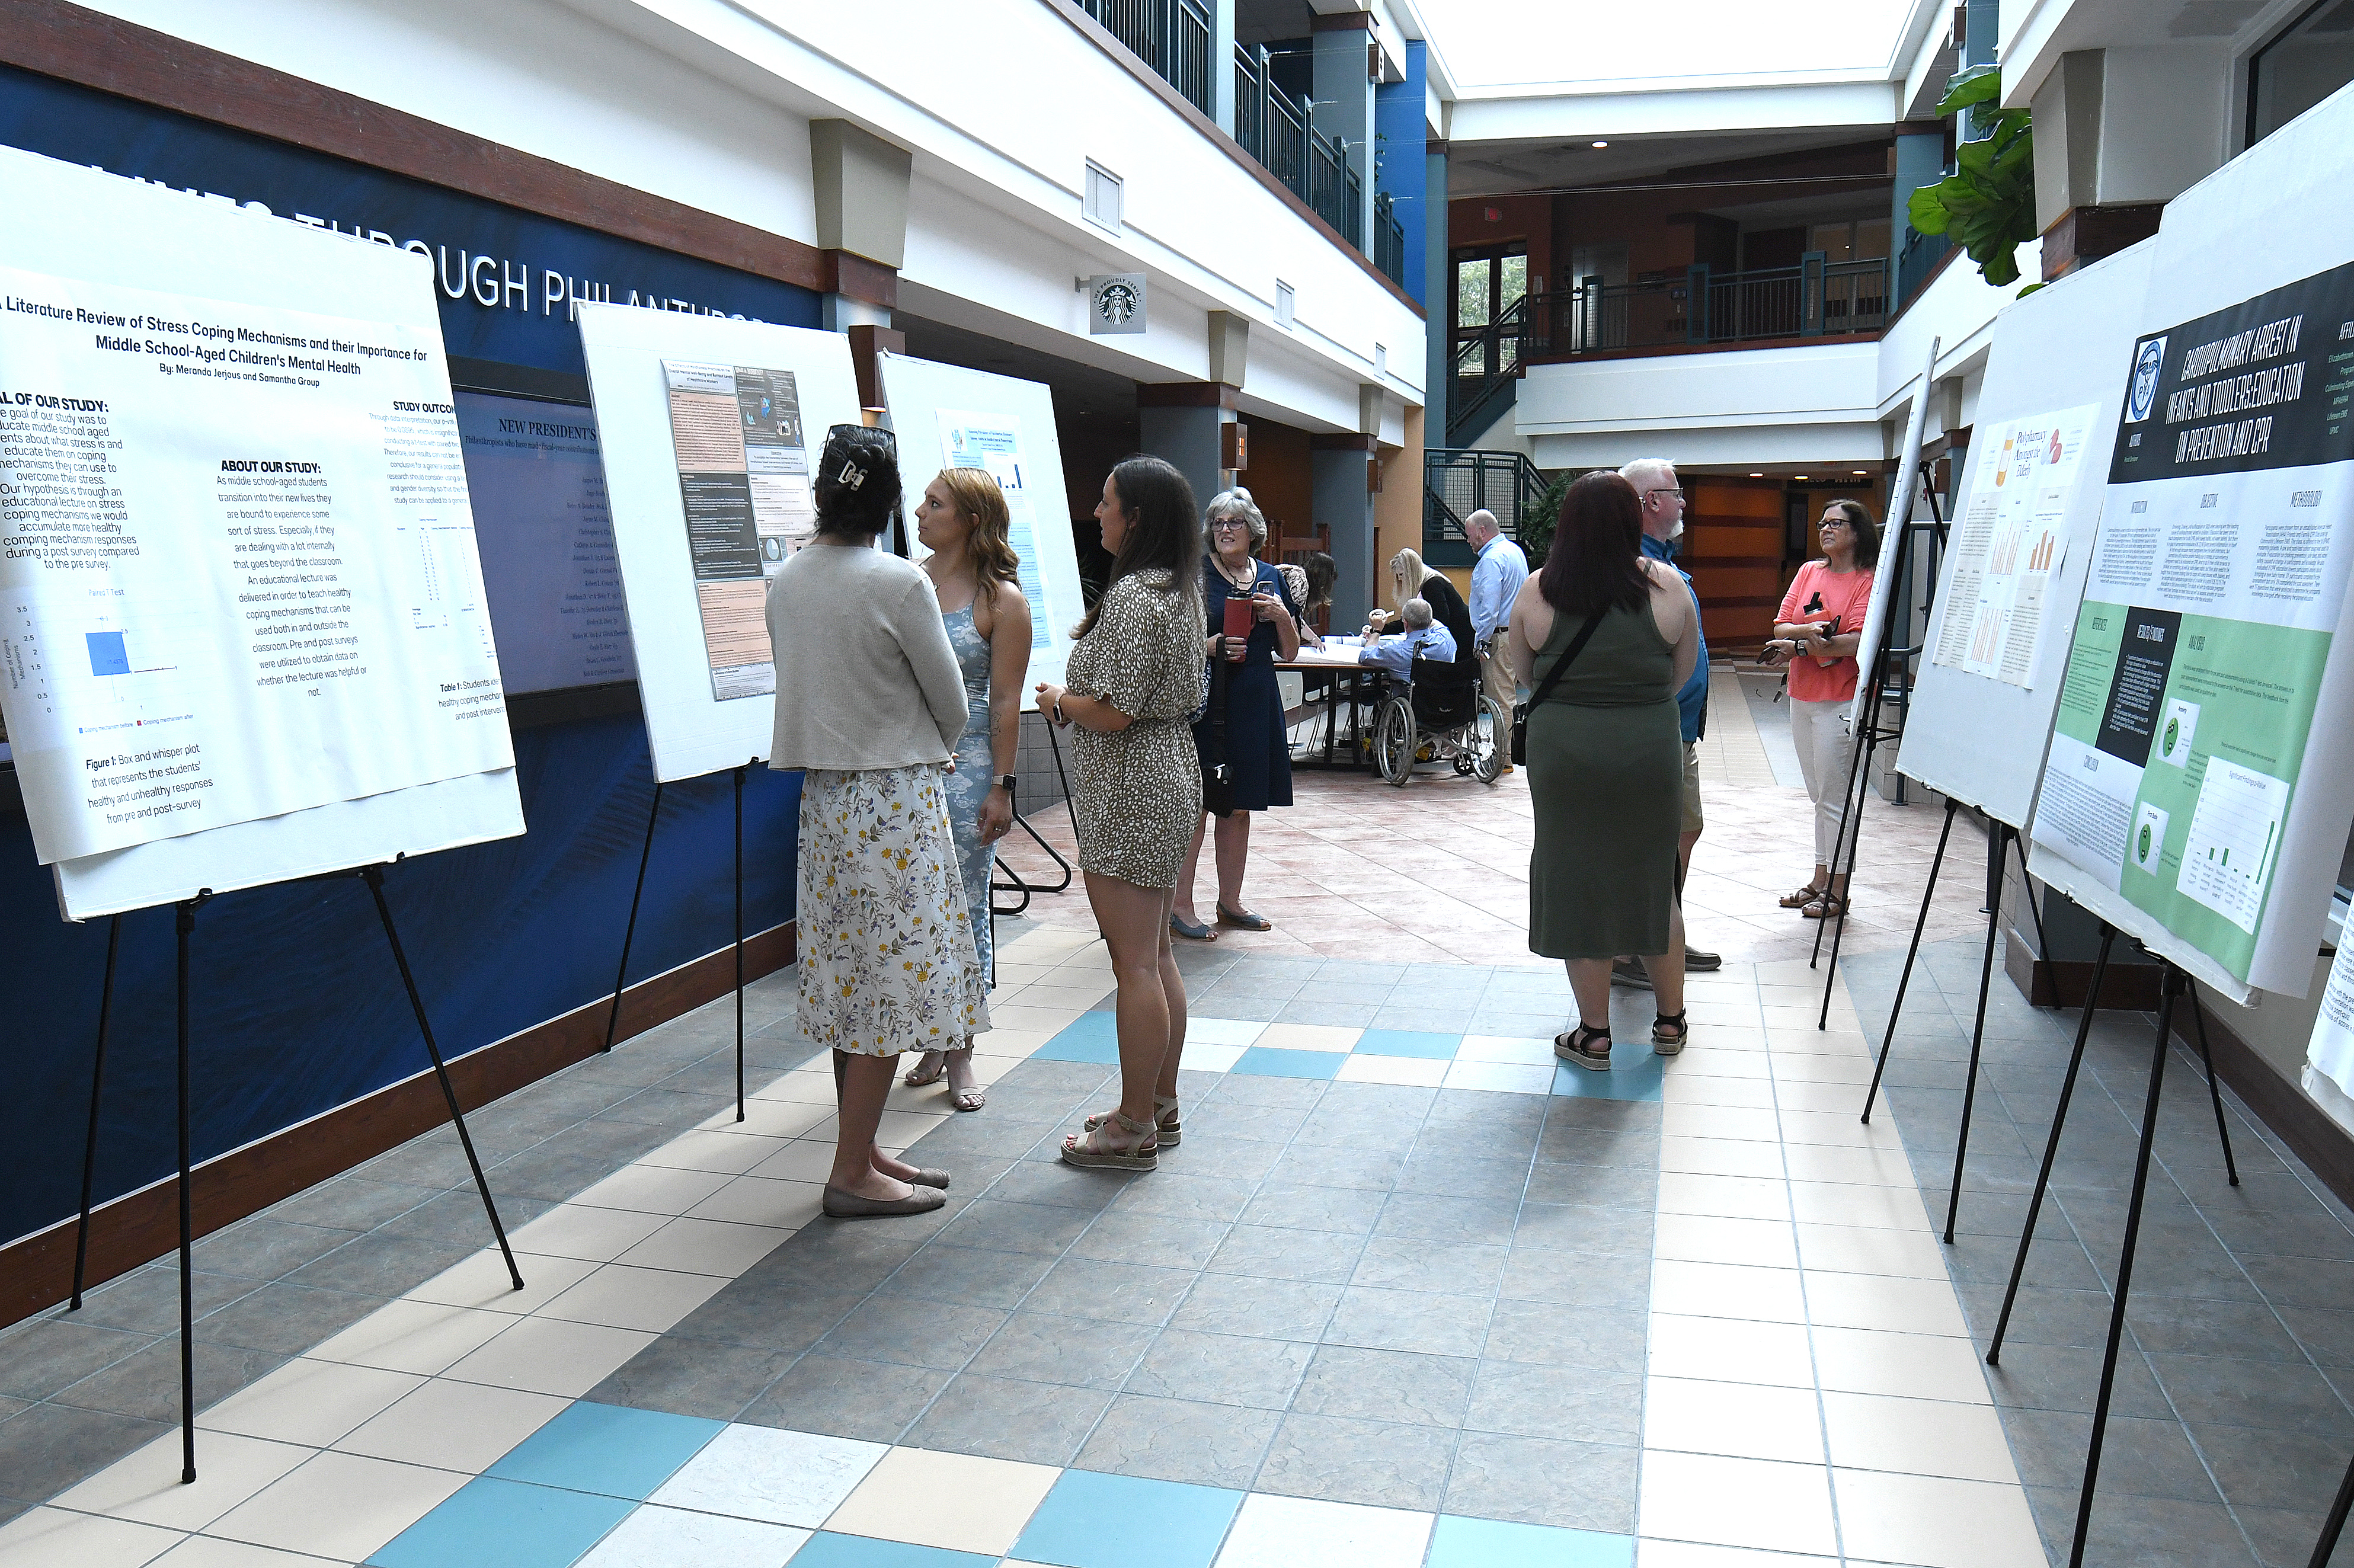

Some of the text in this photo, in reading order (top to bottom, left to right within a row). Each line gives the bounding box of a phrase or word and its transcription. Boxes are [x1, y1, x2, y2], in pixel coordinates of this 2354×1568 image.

[1095, 279, 1141, 299] WE PROUDLY SERVE
[7, 296, 72, 321] Literature
[76, 308, 125, 327] Review
[130, 315, 143, 328] of
[147, 316, 188, 334] Stress
[192, 322, 234, 343] Coping
[238, 327, 306, 348] Mechanisms
[309, 338, 328, 350] and
[331, 340, 354, 353] their
[357, 343, 410, 360] Importance
[414, 349, 427, 361] for
[2181, 328, 2256, 381] CARDIOPULMONARY
[2251, 317, 2291, 363] ARREST
[2286, 314, 2303, 354] IN
[96, 335, 360, 375] Middle School-Aged Children's Mental Health
[159, 363, 319, 388] By: Meranda Jerjous and Samantha Group
[15, 392, 32, 405] OF
[36, 395, 59, 409] OUR
[62, 398, 109, 412] STUDY:
[394, 401, 420, 412] STUDY
[2165, 387, 2196, 424] INFANTS
[2193, 383, 2212, 420] AND
[9, 409, 107, 425] goal of our study was to
[32, 422, 57, 433] middle
[59, 425, 85, 436] school
[87, 427, 109, 439] aged
[499, 419, 526, 433] NEW
[25, 435, 49, 444] about
[51, 437, 69, 446] what
[70, 440, 96, 448] stress
[98, 440, 105, 448] is
[107, 440, 122, 449] and
[465, 436, 503, 446] Philanthropists
[516, 440, 527, 449] have
[2017, 430, 2047, 446] Polypharmacy
[2175, 416, 2273, 463] ON PREVENTION AND CPR
[5, 446, 43, 456] educate
[45, 448, 65, 457] them
[77, 452, 106, 462] coping
[2014, 448, 2033, 462] Amongst
[56, 460, 72, 473] they
[73, 463, 88, 472] can
[108, 463, 116, 472] to
[222, 460, 321, 473] ABOUT OUR STUDY:
[2016, 463, 2030, 479] Elderly
[17, 473, 105, 484] overcome their stress.
[217, 476, 327, 488] As middle school-aged students
[0, 484, 122, 499] Our hypothesis is through an
[2290, 490, 2323, 507] METHODOLOGY
[1, 497, 58, 507] educational
[59, 498, 85, 507] lecture
[98, 500, 124, 508] stress
[4, 510, 39, 521] coping
[41, 510, 89, 520] mechanisms
[103, 511, 127, 520] would
[19, 522, 70, 532] accumulate
[91, 523, 121, 535] healthy
[4, 535, 136, 546] comping mechanism responses
[6, 546, 41, 558] during
[51, 548, 69, 558] post
[98, 546, 139, 558] compared
[45, 559, 110, 571] to the pre survey.
[308, 687, 321, 697] not.
[440, 683, 456, 692] Table
[463, 679, 490, 689] Students
[439, 695, 479, 708] healthy coping
[456, 710, 479, 720] and post
[86, 743, 200, 771] Figure 1: Box and whisper plot
[91, 761, 201, 788] that represents the students'
[88, 778, 213, 808] healthy and unhealthy responses
[107, 799, 201, 824] from pre and post-survey
